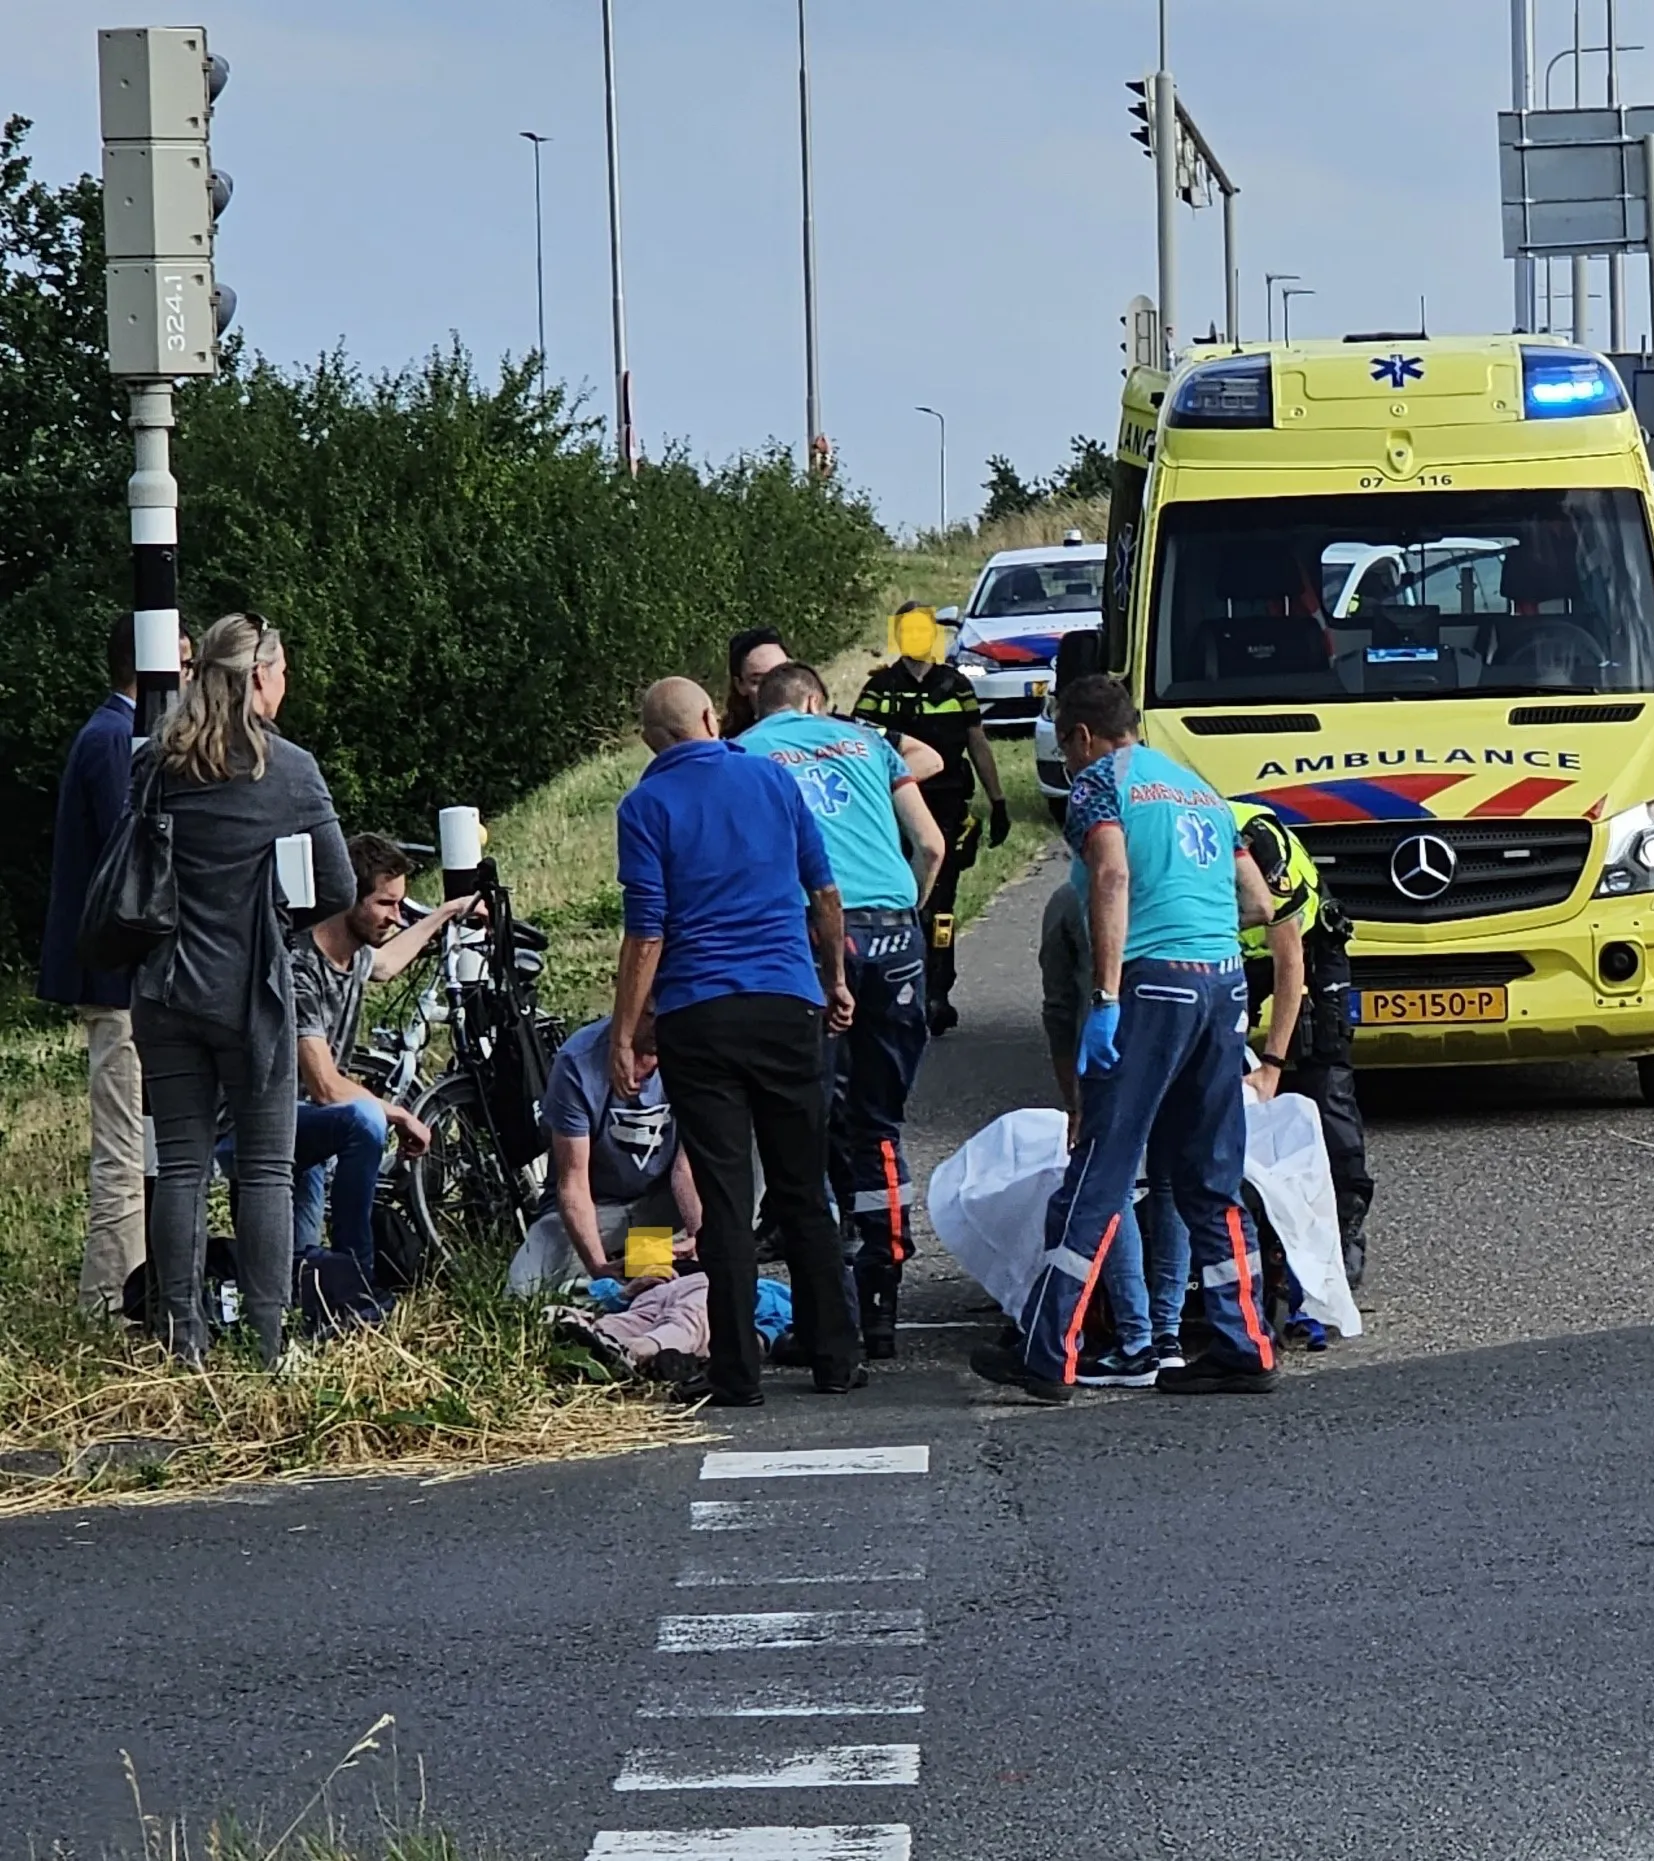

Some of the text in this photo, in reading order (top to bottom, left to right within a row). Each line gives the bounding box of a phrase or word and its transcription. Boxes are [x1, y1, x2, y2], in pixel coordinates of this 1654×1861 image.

[163, 275, 186, 352] 324.1
[1359, 474, 1453, 489] 07 116
[769, 740, 870, 766] BULANCE
[1255, 748, 1582, 781] AMBULANCE
[1373, 992, 1494, 1019] PS-150-P
